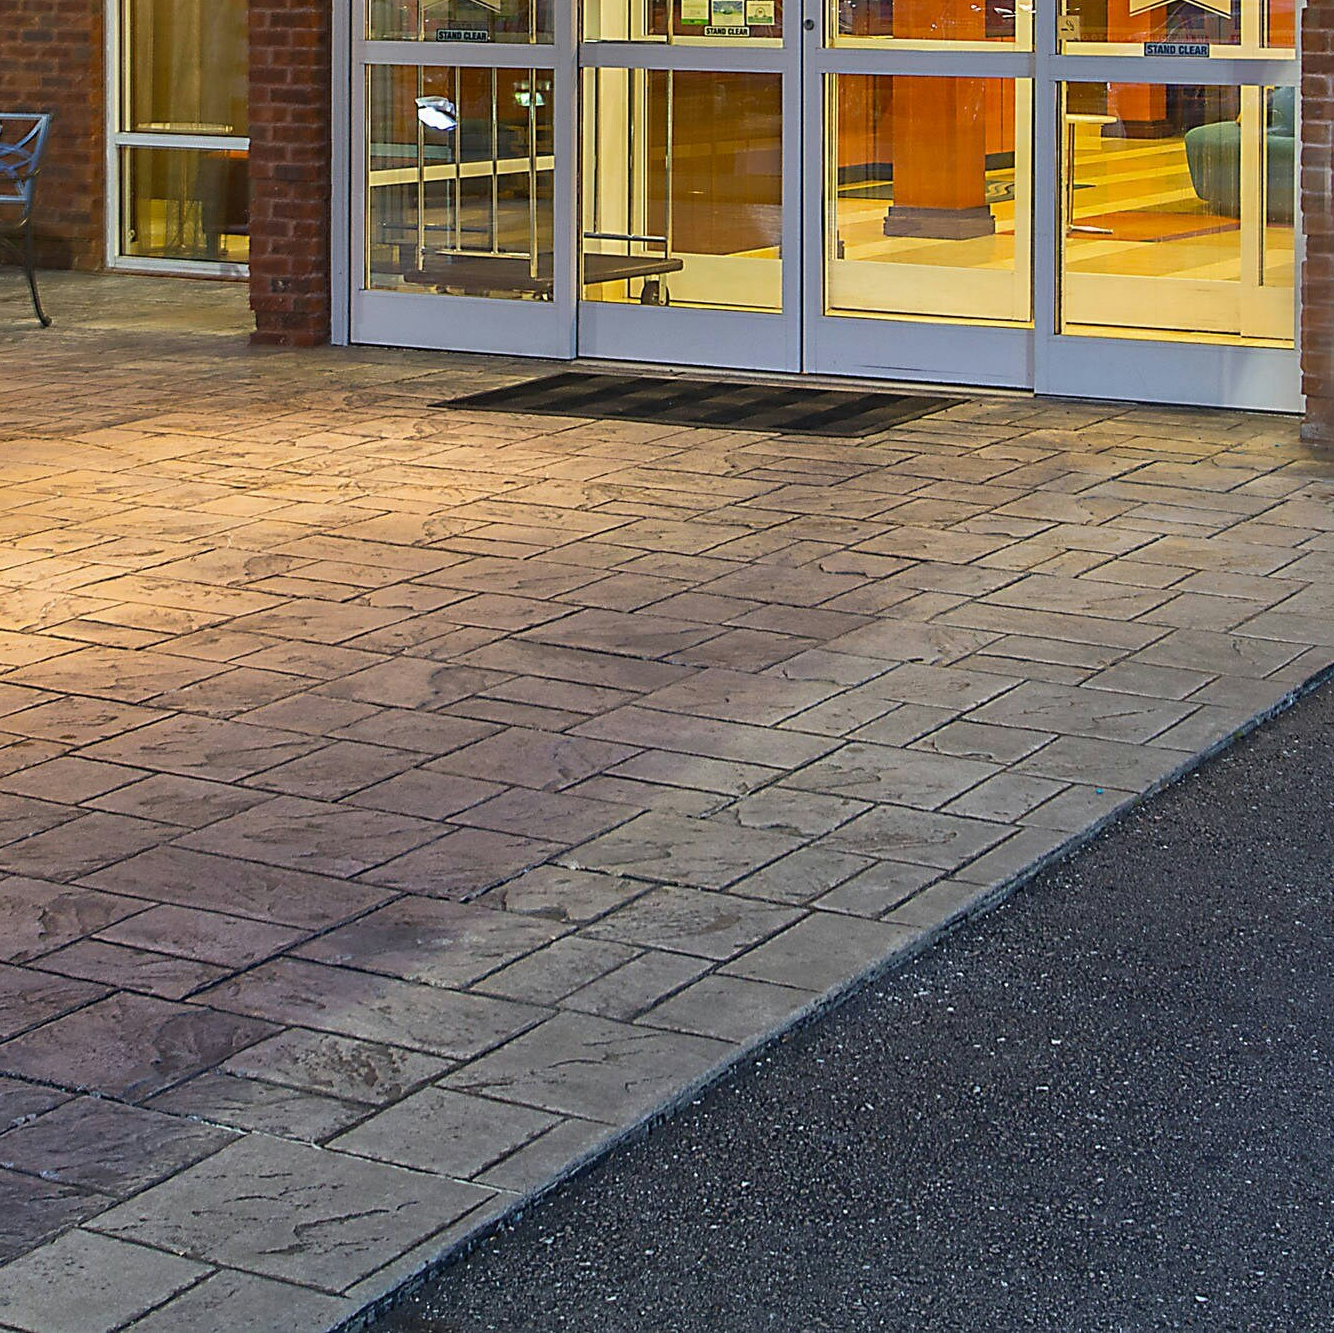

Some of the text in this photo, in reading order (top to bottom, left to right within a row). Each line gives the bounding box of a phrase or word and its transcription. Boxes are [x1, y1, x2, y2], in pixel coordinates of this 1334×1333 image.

[438, 30, 487, 41] STAND CLEAR
[706, 27, 748, 36] STAND CLEAR
[1146, 44, 1208, 56] STAND CLEAR
